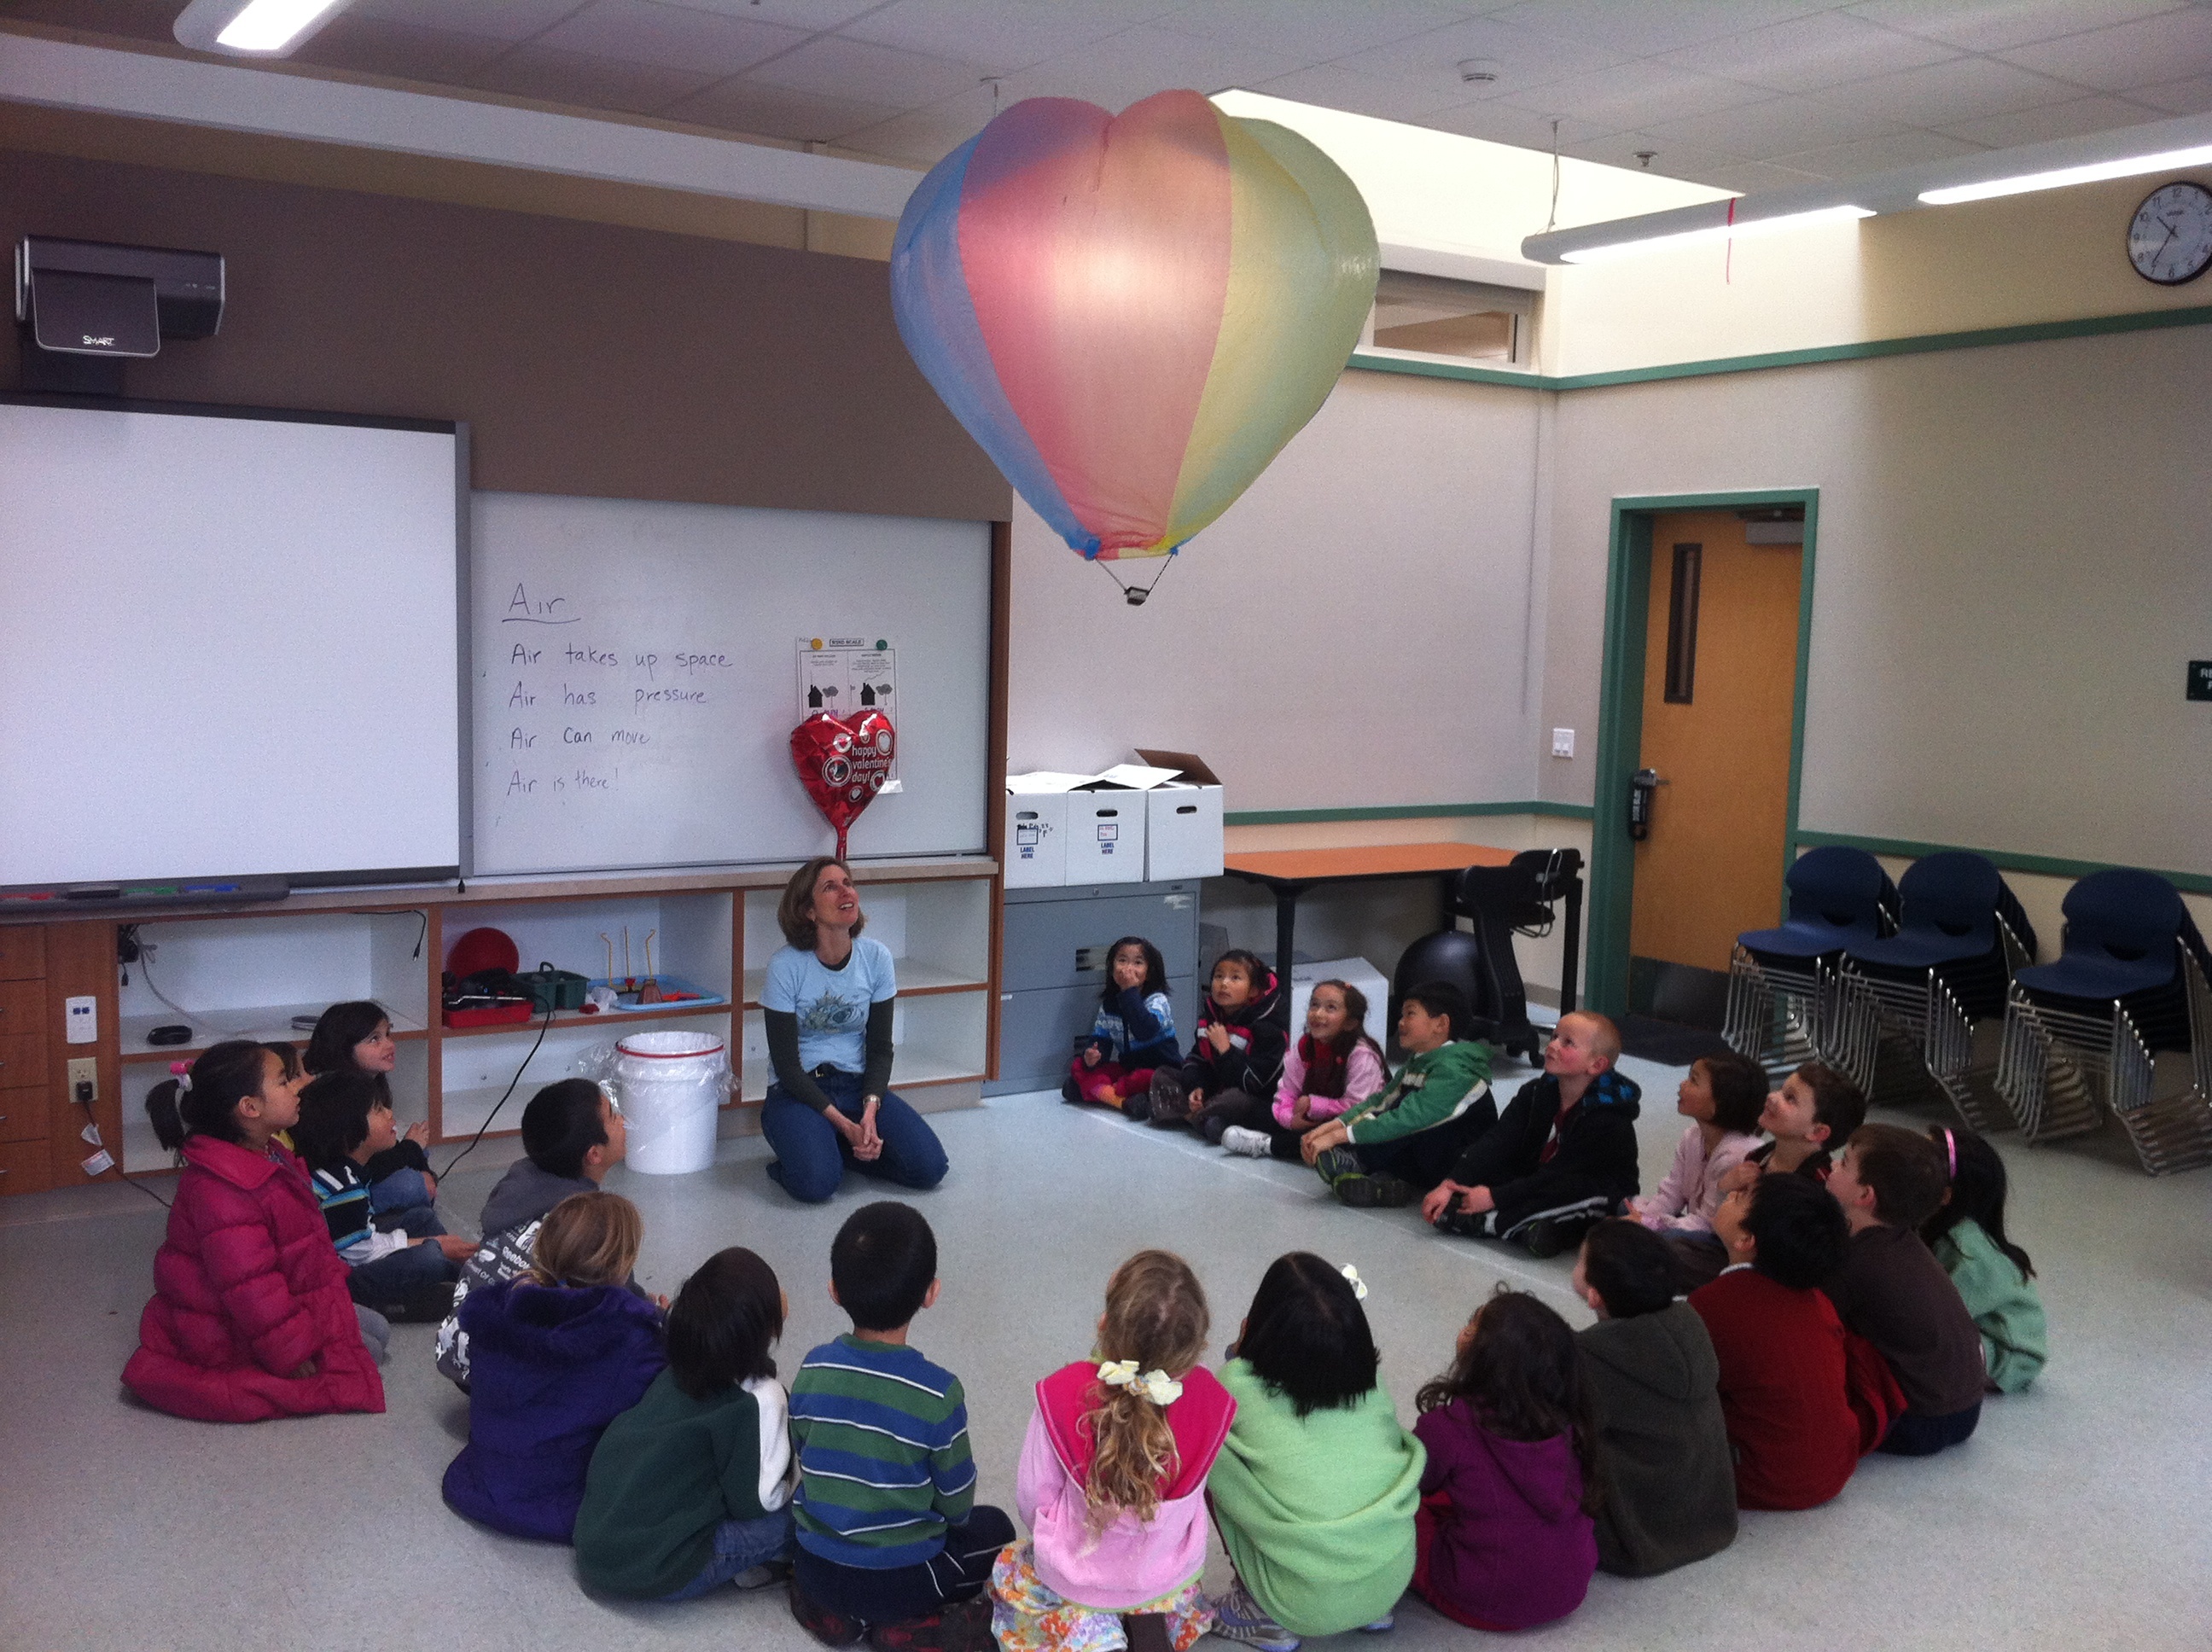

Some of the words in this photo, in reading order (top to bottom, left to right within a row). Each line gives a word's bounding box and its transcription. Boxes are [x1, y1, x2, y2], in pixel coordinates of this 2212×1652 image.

[83, 335, 115, 346] SMART
[509, 583, 565, 614] Air
[511, 643, 542, 666] Air
[565, 643, 618, 666] takes
[636, 654, 657, 682] up
[675, 653, 733, 676] space
[509, 681, 536, 708] Air
[564, 683, 597, 706] has
[635, 689, 707, 714] pressure
[510, 727, 537, 749] Air
[611, 730, 651, 745] move
[852, 745, 876, 758] happy
[507, 770, 538, 795] Air
[553, 776, 565, 791] is
[852, 771, 870, 784] day!
